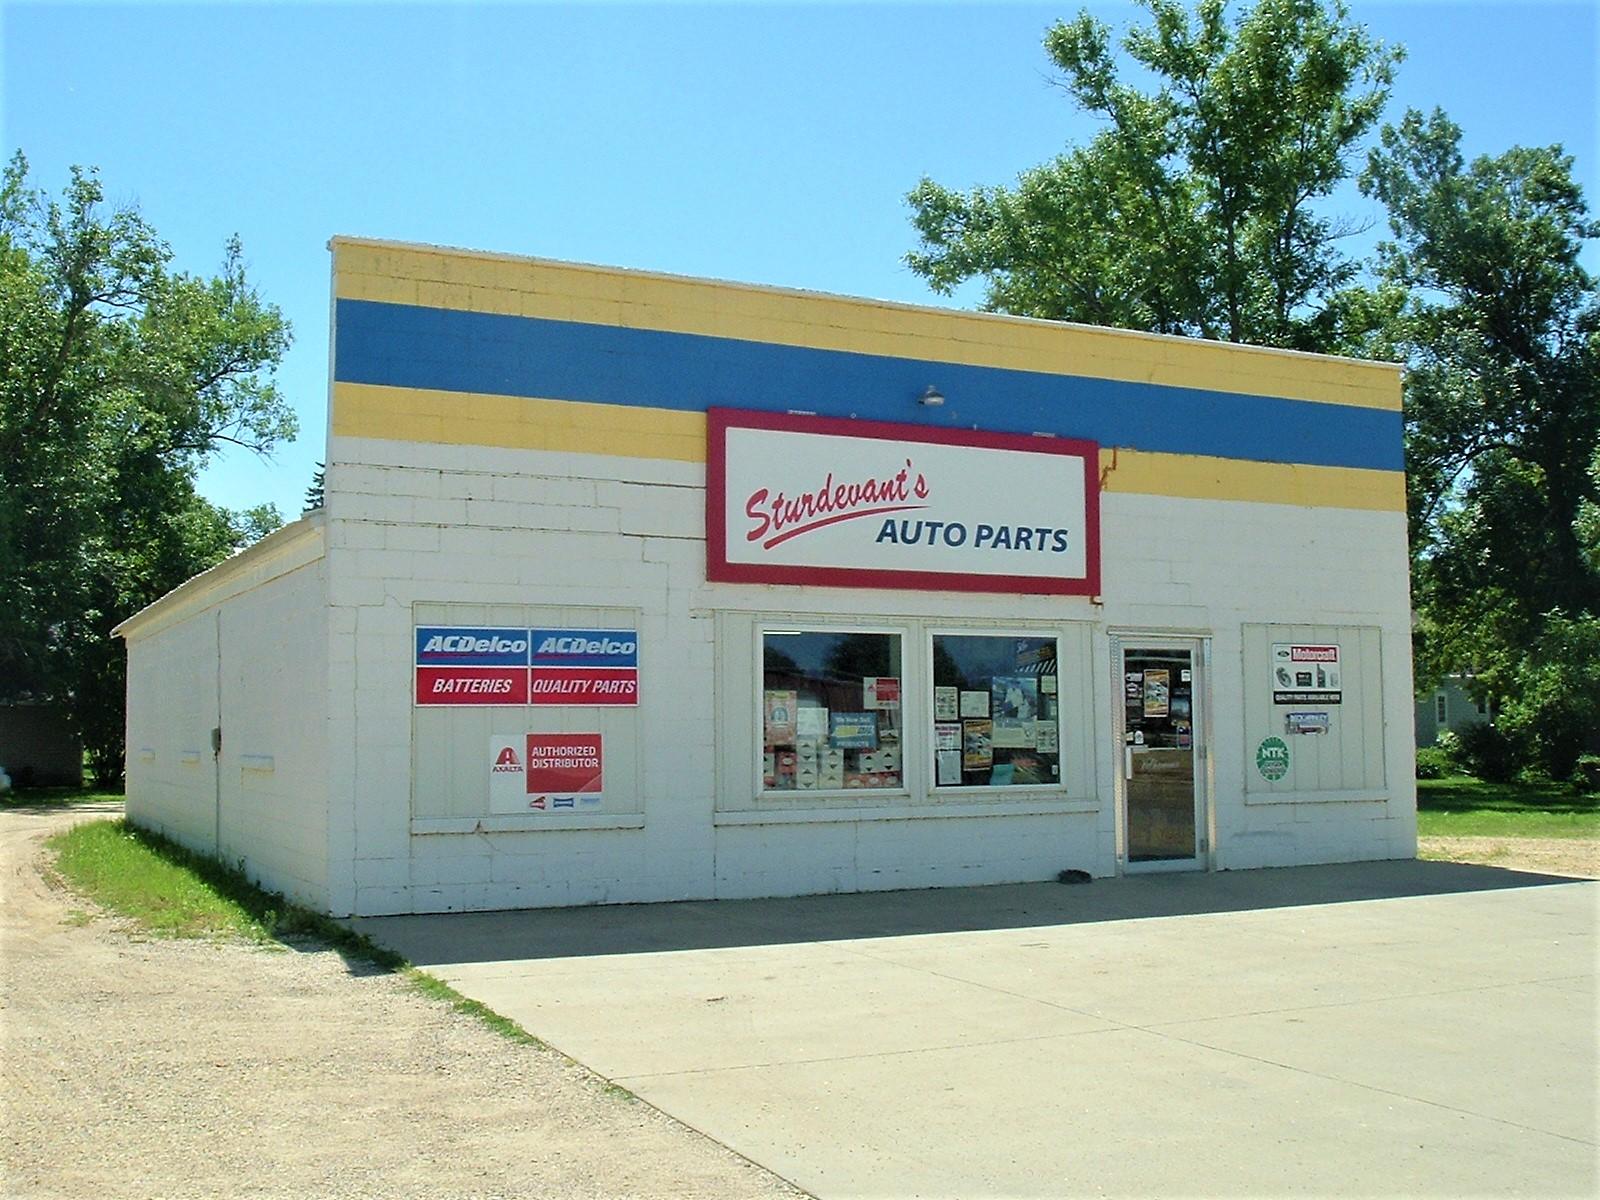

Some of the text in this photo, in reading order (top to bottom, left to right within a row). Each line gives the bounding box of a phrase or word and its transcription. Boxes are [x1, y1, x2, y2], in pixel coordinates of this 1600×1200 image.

[744, 458, 930, 542] Sturdevant's
[875, 518, 1068, 552] AUTO PARTS
[424, 635, 527, 653] ACDelco
[537, 637, 635, 655] ACDelco
[433, 678, 512, 693] BATTERIES
[532, 679, 636, 694] QUALITY PARTS
[532, 746, 596, 757] AUTHORIZED
[1262, 747, 1285, 758] NTK
[532, 758, 599, 769] DISTRIBUTOR
